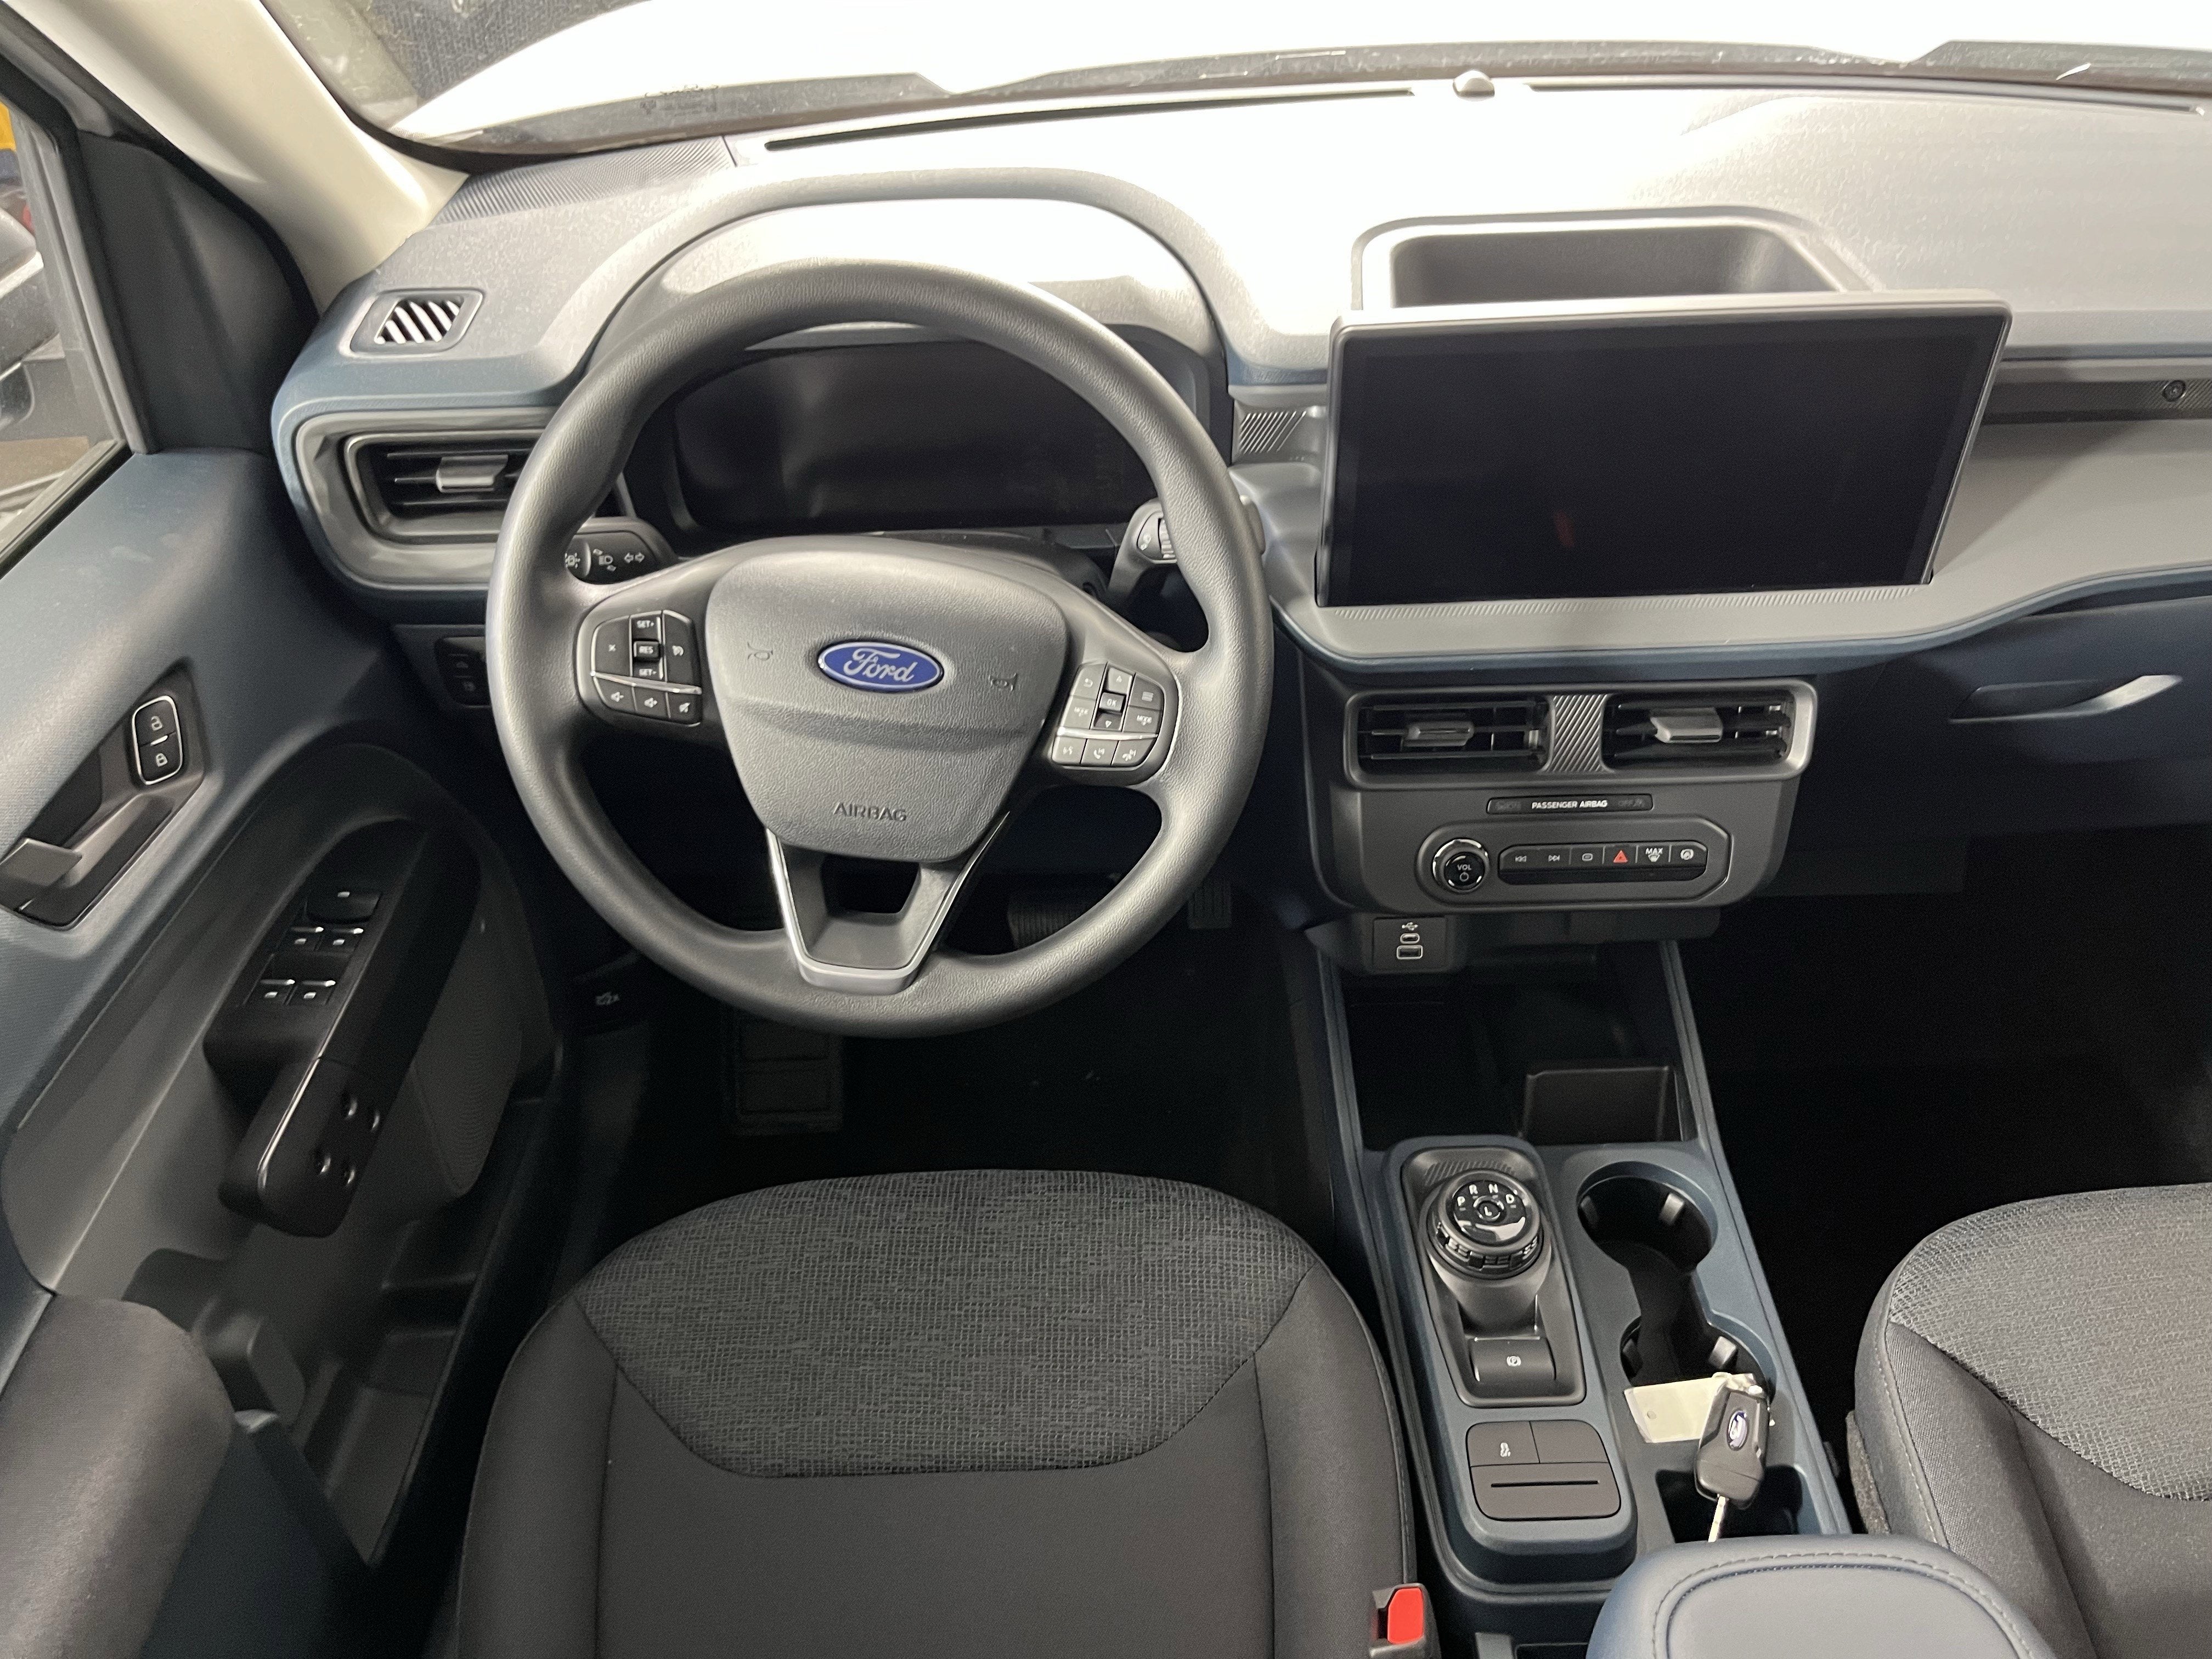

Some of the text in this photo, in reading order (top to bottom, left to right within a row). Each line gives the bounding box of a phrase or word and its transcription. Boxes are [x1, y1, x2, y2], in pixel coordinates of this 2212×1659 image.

[639, 646, 654, 654] RES
[843, 648, 918, 682] Ford
[1107, 698, 1117, 707] OK
[1531, 801, 1578, 809] PASSENGER
[1579, 800, 1608, 809] AIRBAG
[833, 802, 906, 822] AIRBAG
[1457, 1184, 1515, 1206] P R N D
[1484, 1206, 1492, 1216] L
